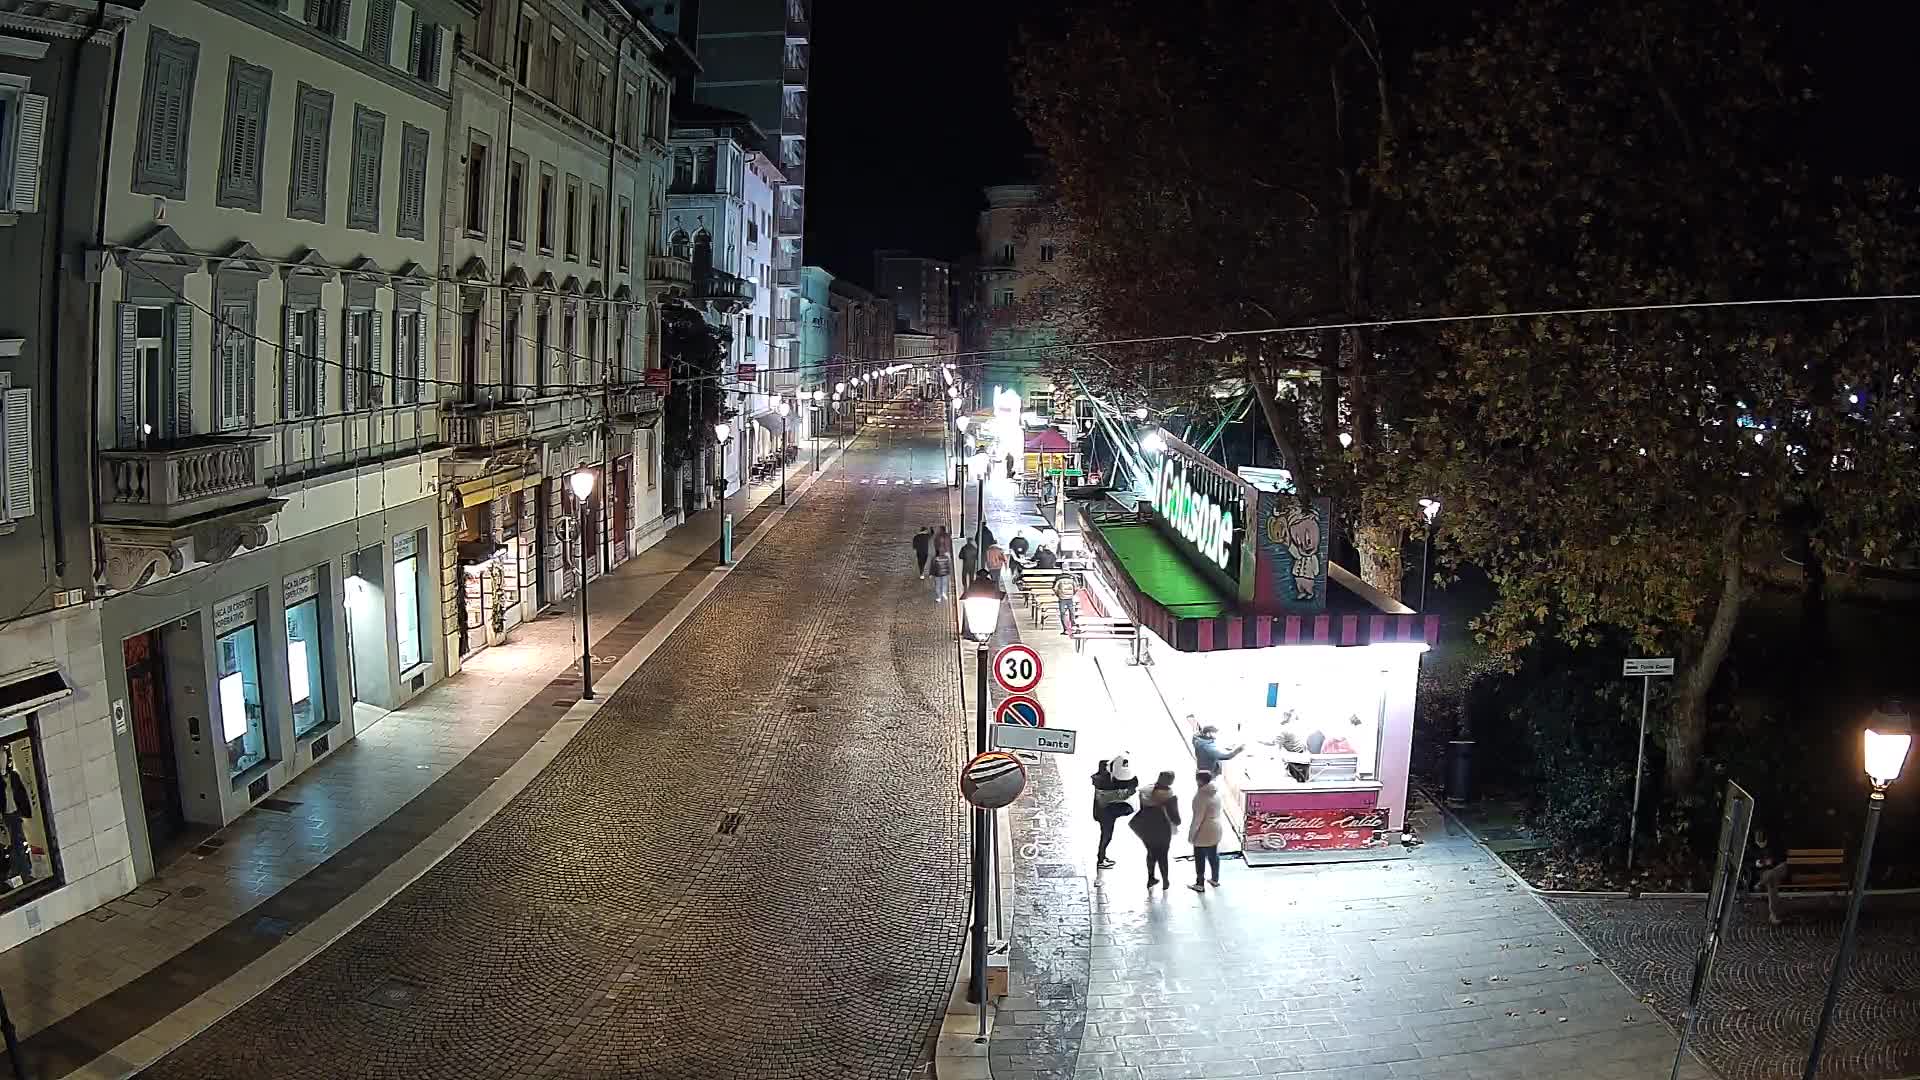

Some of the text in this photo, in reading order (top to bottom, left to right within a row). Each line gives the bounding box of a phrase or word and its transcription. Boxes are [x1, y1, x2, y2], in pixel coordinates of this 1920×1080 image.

[1161, 458, 1233, 569] Golosone
[1005, 657, 1033, 680] 30
[1038, 737, 1070, 749] Dante
